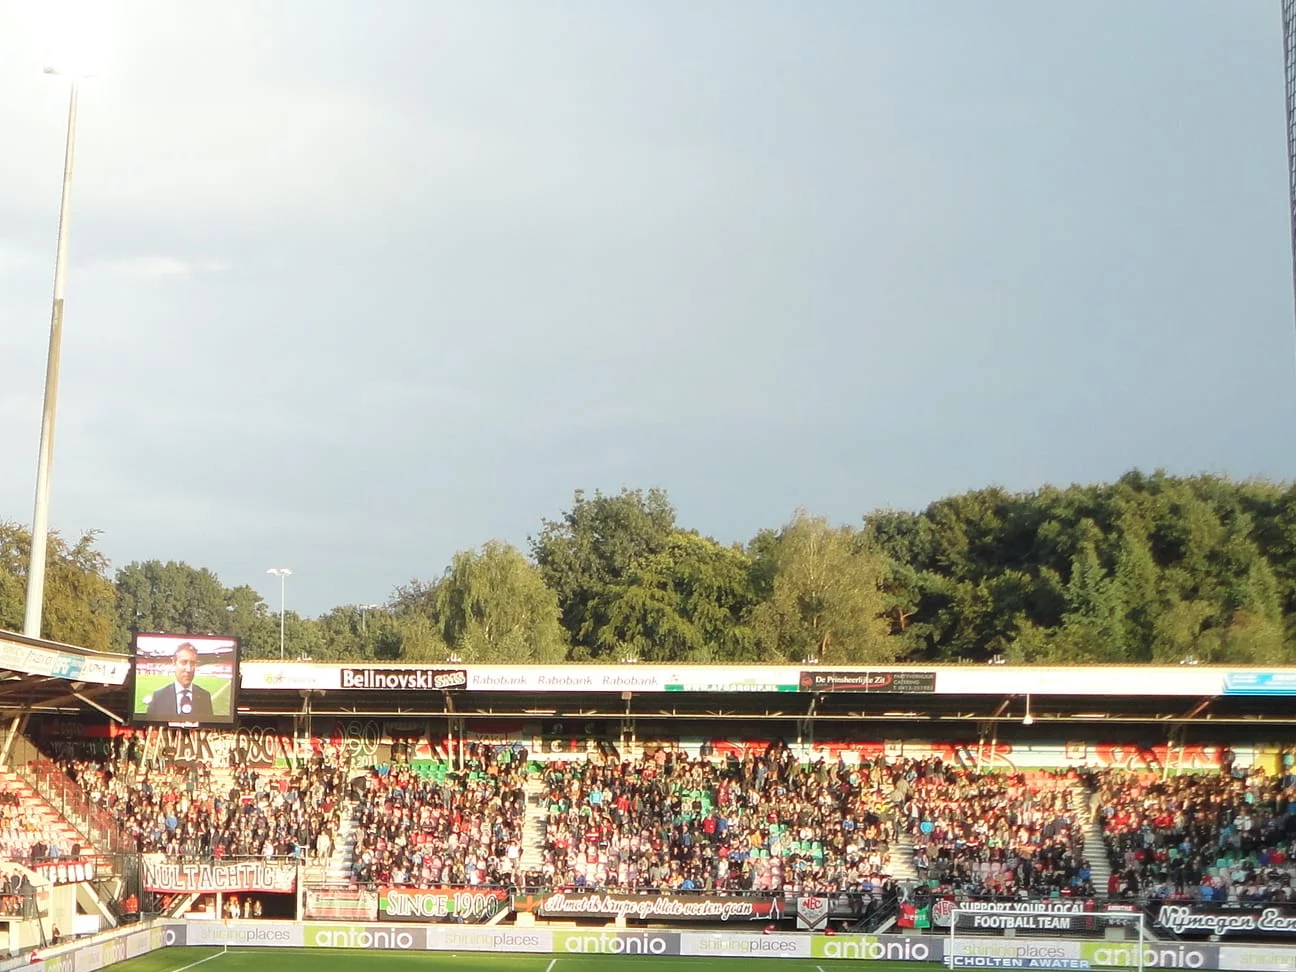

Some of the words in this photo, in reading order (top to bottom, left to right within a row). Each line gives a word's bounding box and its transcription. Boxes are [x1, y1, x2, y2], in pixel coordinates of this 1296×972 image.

[343, 669, 433, 689] Bellnovski
[472, 673, 528, 686] Rabobank
[537, 673, 593, 686] Rabobank
[602, 674, 658, 687] Rabobank
[386, 889, 450, 917] SINCE
[453, 894, 499, 919] 1900
[959, 902, 1012, 913] SUPPORT
[1014, 902, 1045, 914] YOUR
[973, 915, 1036, 929] FOOTBALL
[1037, 917, 1071, 929] TEAM
[1158, 905, 1255, 935] Nijmegen
[315, 927, 413, 949] antonio
[564, 932, 667, 955] antonio
[699, 937, 797, 955] shiningplaces
[823, 937, 930, 960] antonio
[1093, 945, 1204, 969] antonio
[943, 956, 1026, 968] SCHOLTEN
[1029, 958, 1092, 969] AWATER
